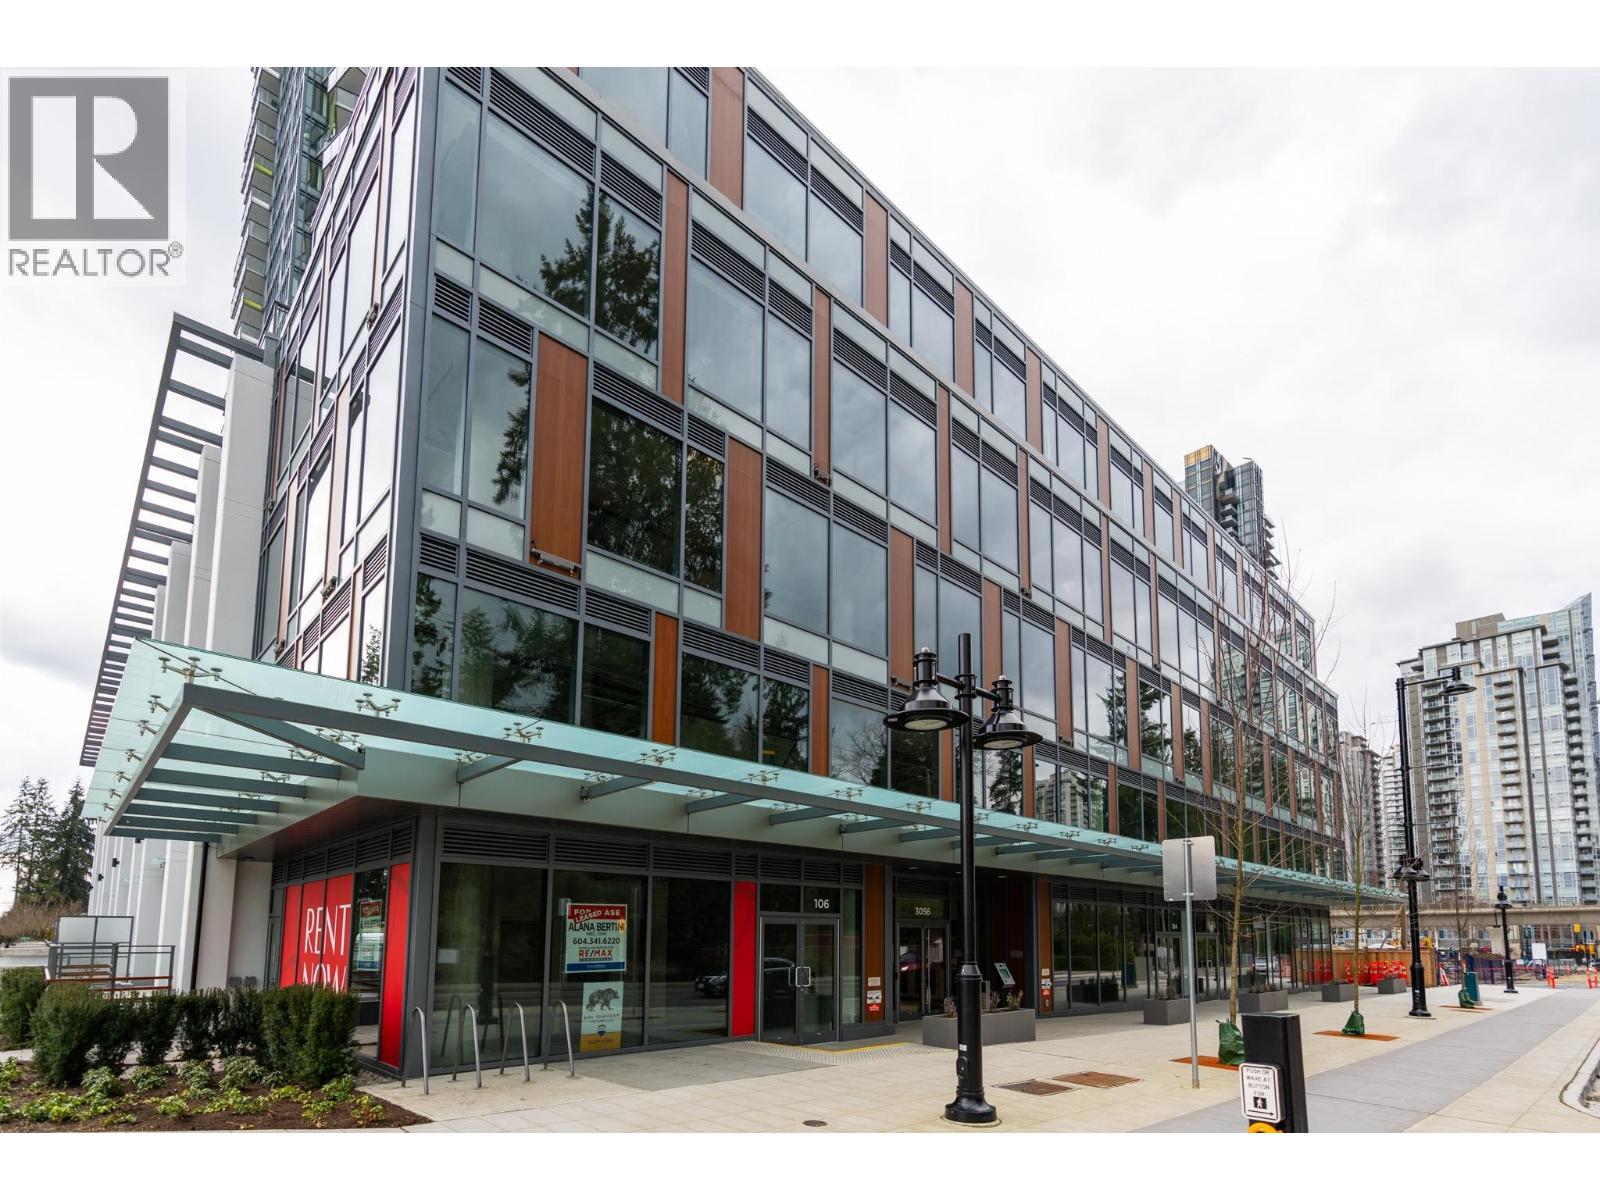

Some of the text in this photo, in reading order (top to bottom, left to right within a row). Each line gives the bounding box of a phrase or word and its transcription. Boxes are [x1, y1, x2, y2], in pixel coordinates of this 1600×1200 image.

[813, 898, 830, 910] 106
[304, 904, 351, 956] RENT
[568, 922, 595, 931] ALANA
[573, 937, 621, 945] 604.341.6220
[579, 949, 613, 958] RE/MAX
